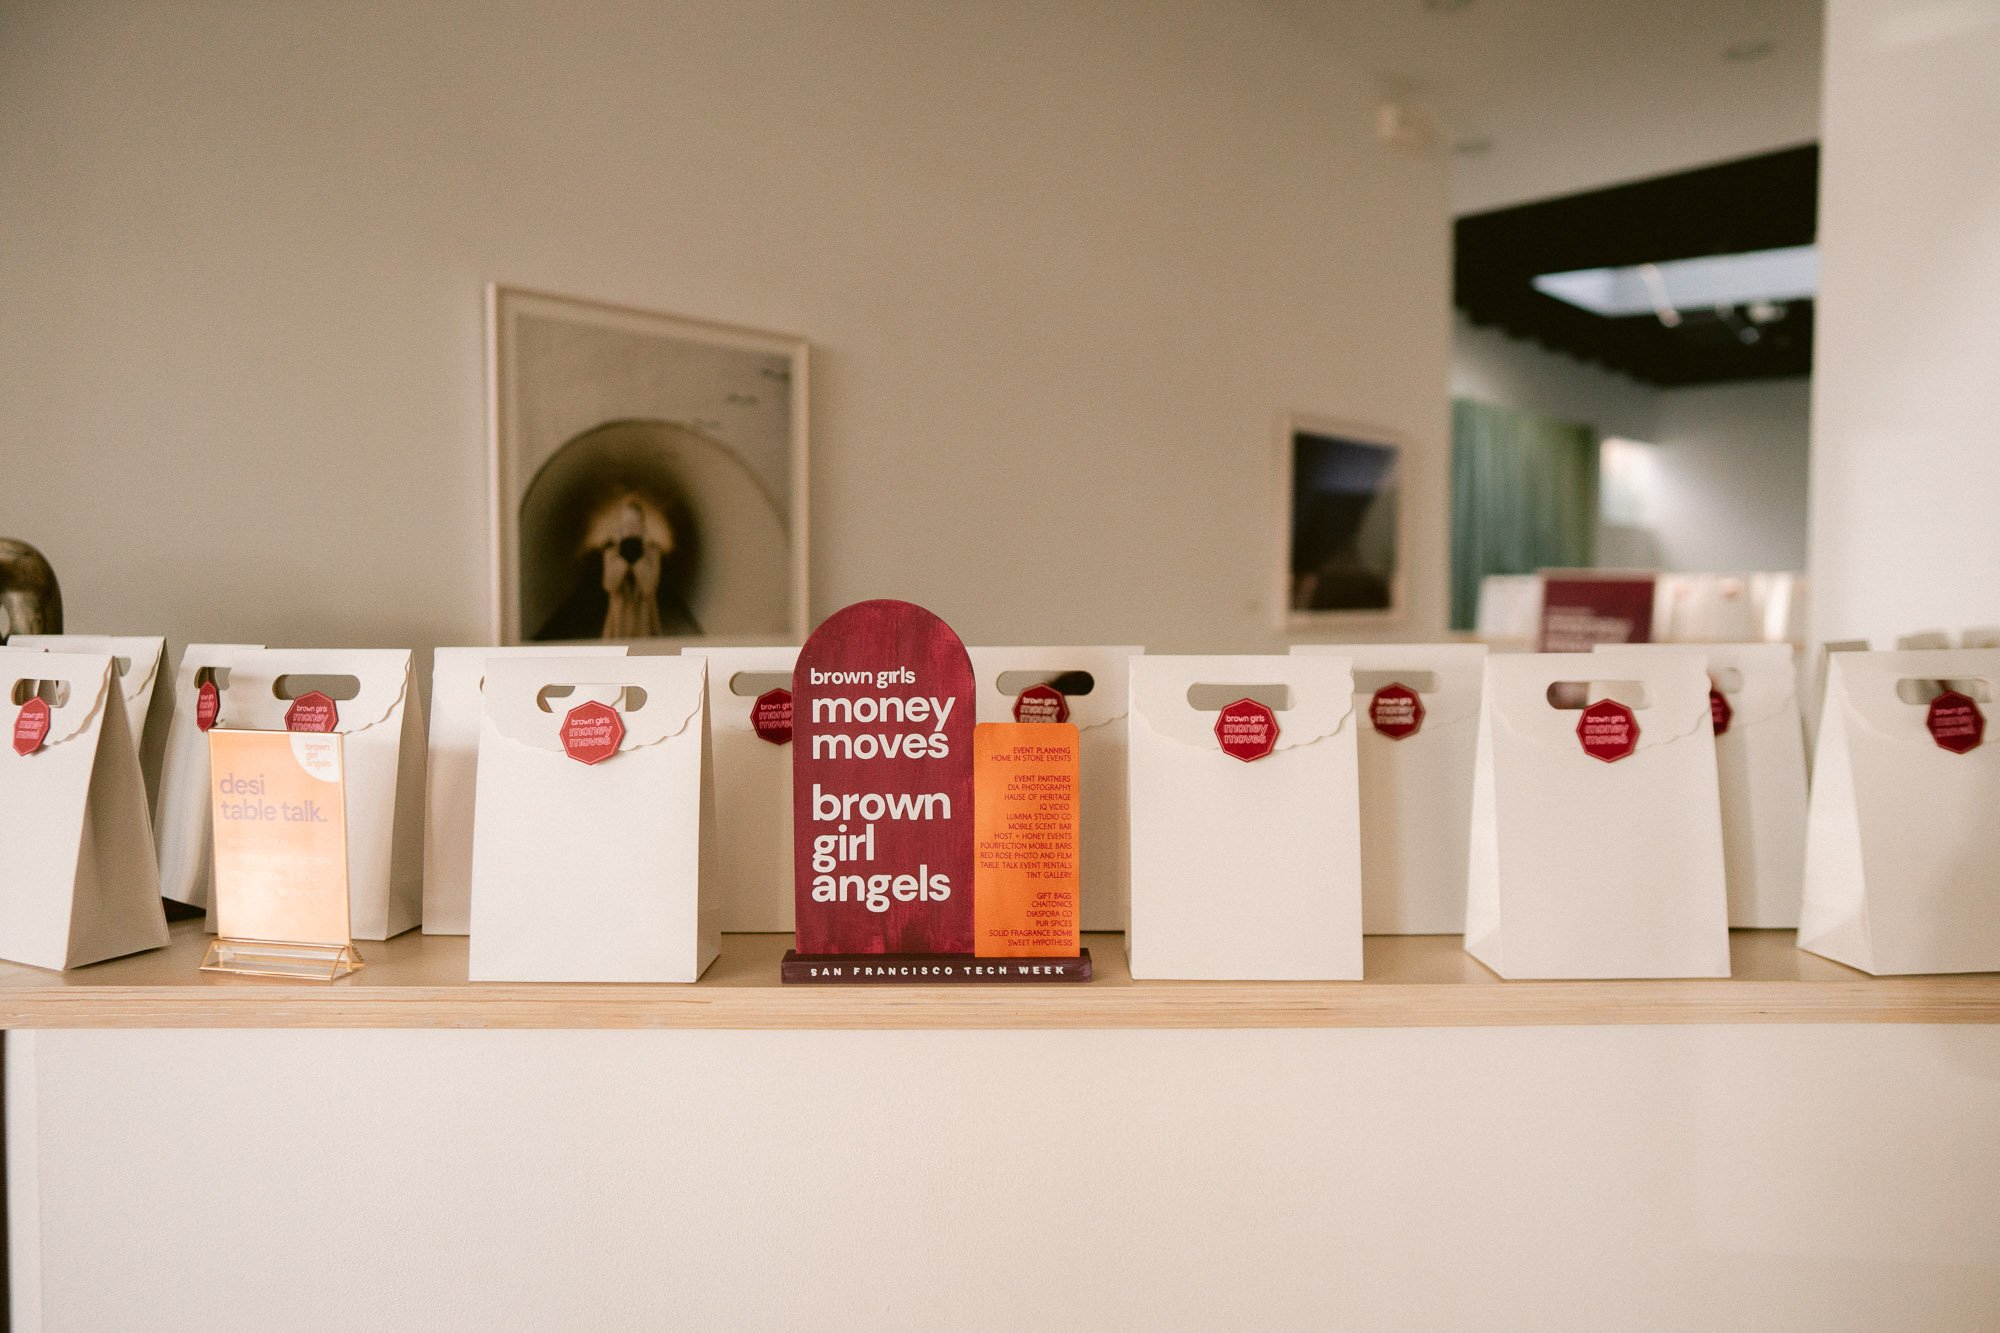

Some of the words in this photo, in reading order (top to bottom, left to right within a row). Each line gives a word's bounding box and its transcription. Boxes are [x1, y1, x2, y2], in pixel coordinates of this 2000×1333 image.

[811, 668, 872, 684] brown
[877, 666, 915, 689] girls
[316, 705, 327, 713] girls
[812, 697, 956, 732] money
[596, 716, 610, 726] girls
[1251, 715, 1265, 723] girls
[1611, 716, 1625, 724] girls
[569, 726, 612, 737] money
[1224, 724, 1268, 736] money
[1585, 724, 1629, 736] money
[569, 736, 610, 747] moves
[1224, 735, 1266, 744] moves
[812, 733, 949, 759] moves
[220, 773, 264, 795] desi
[813, 784, 951, 821] brown
[221, 799, 276, 820] table
[281, 800, 328, 822] talk.
[812, 824, 874, 873] girl
[812, 864, 951, 912] angels
[810, 967, 842, 976] SAN
[853, 966, 953, 976] FRANCISCO
[964, 966, 1007, 975] TECH
[1019, 966, 1064, 975] WEEK
